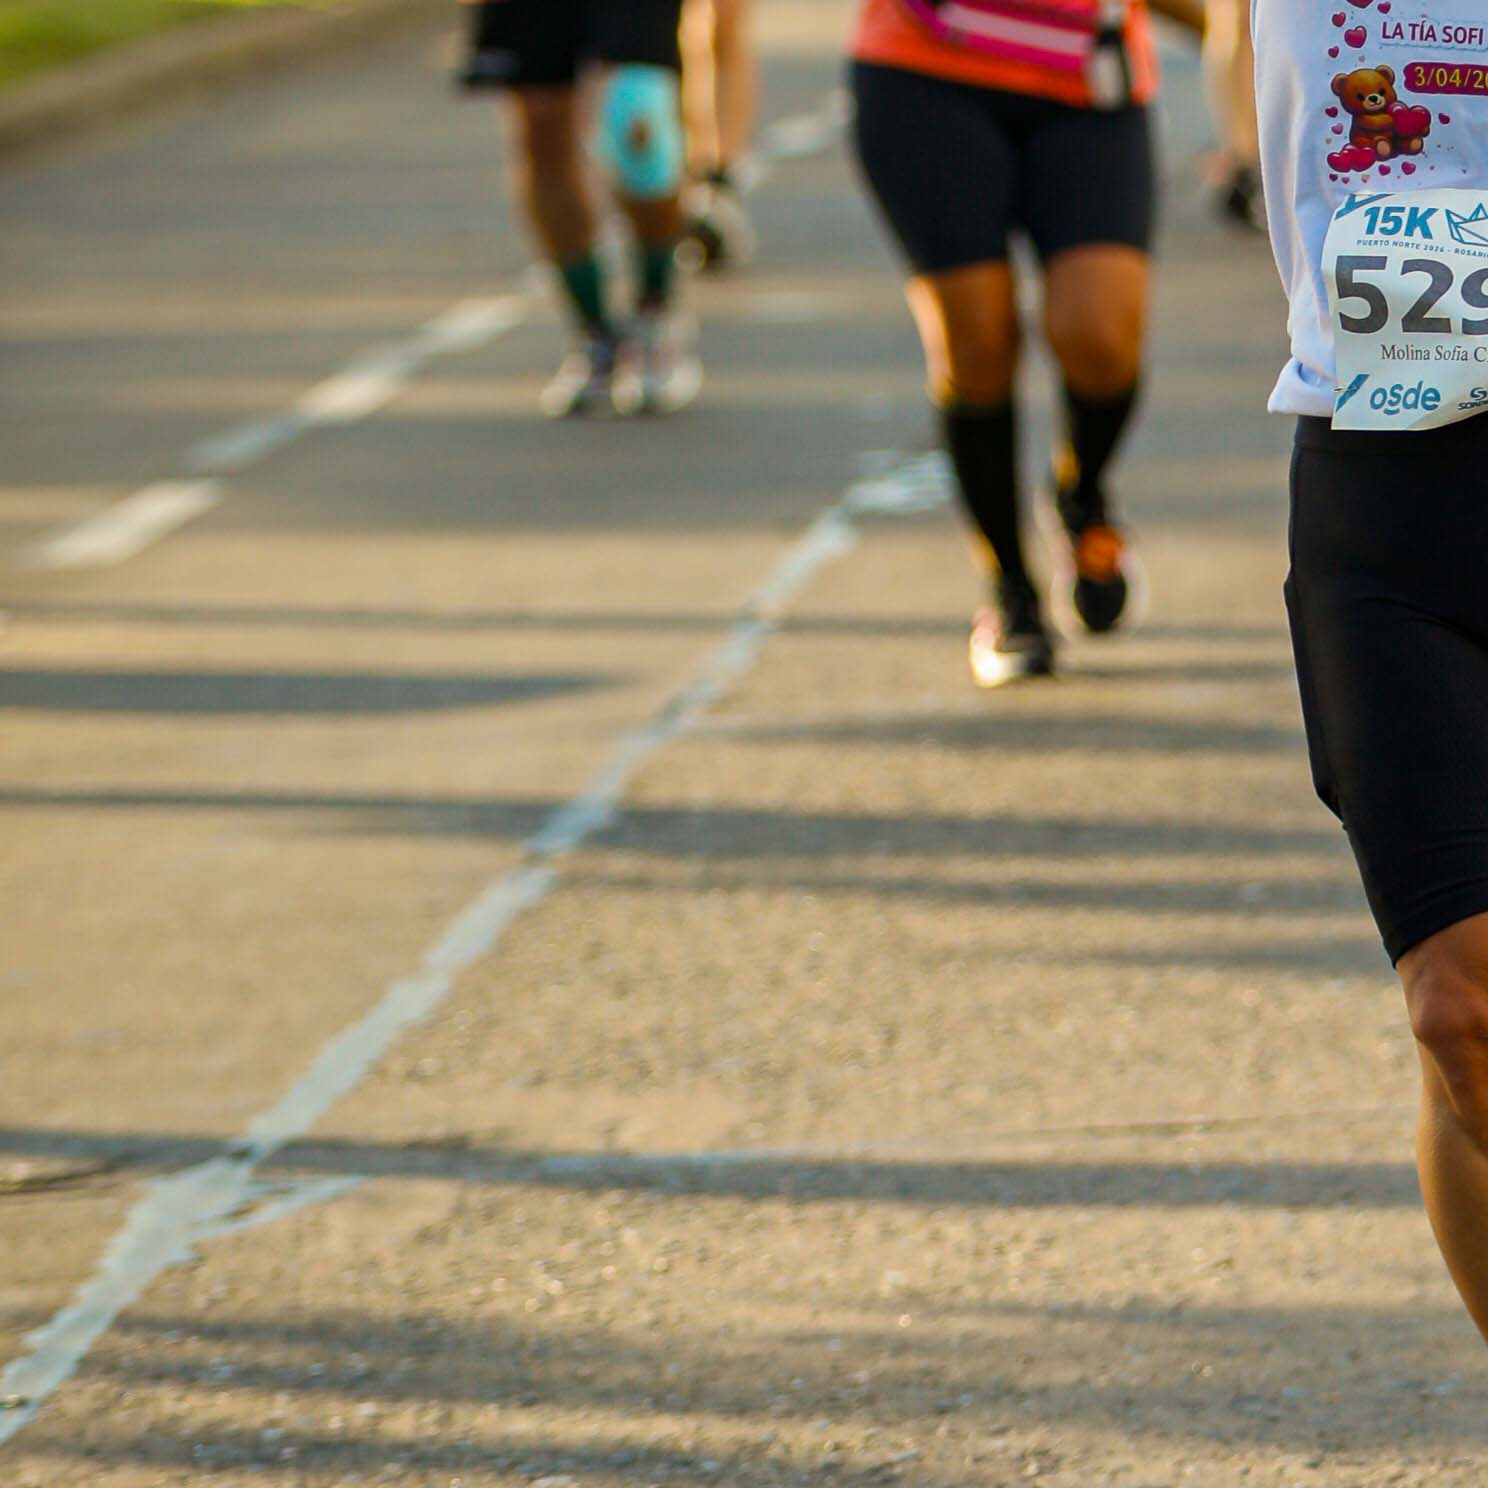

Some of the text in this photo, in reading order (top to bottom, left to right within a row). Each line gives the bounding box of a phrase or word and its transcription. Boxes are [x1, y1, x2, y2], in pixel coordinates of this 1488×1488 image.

[1382, 21, 1404, 40] LA
[1408, 20, 1437, 42] TÍA
[1441, 26, 1483, 45] SOFI
[1364, 206, 1439, 240] 15K
[1356, 239, 1390, 247] PUERTO
[1392, 241, 1421, 250] NORTE
[1381, 344, 1430, 361] Molina
[1370, 381, 1441, 412] osde
